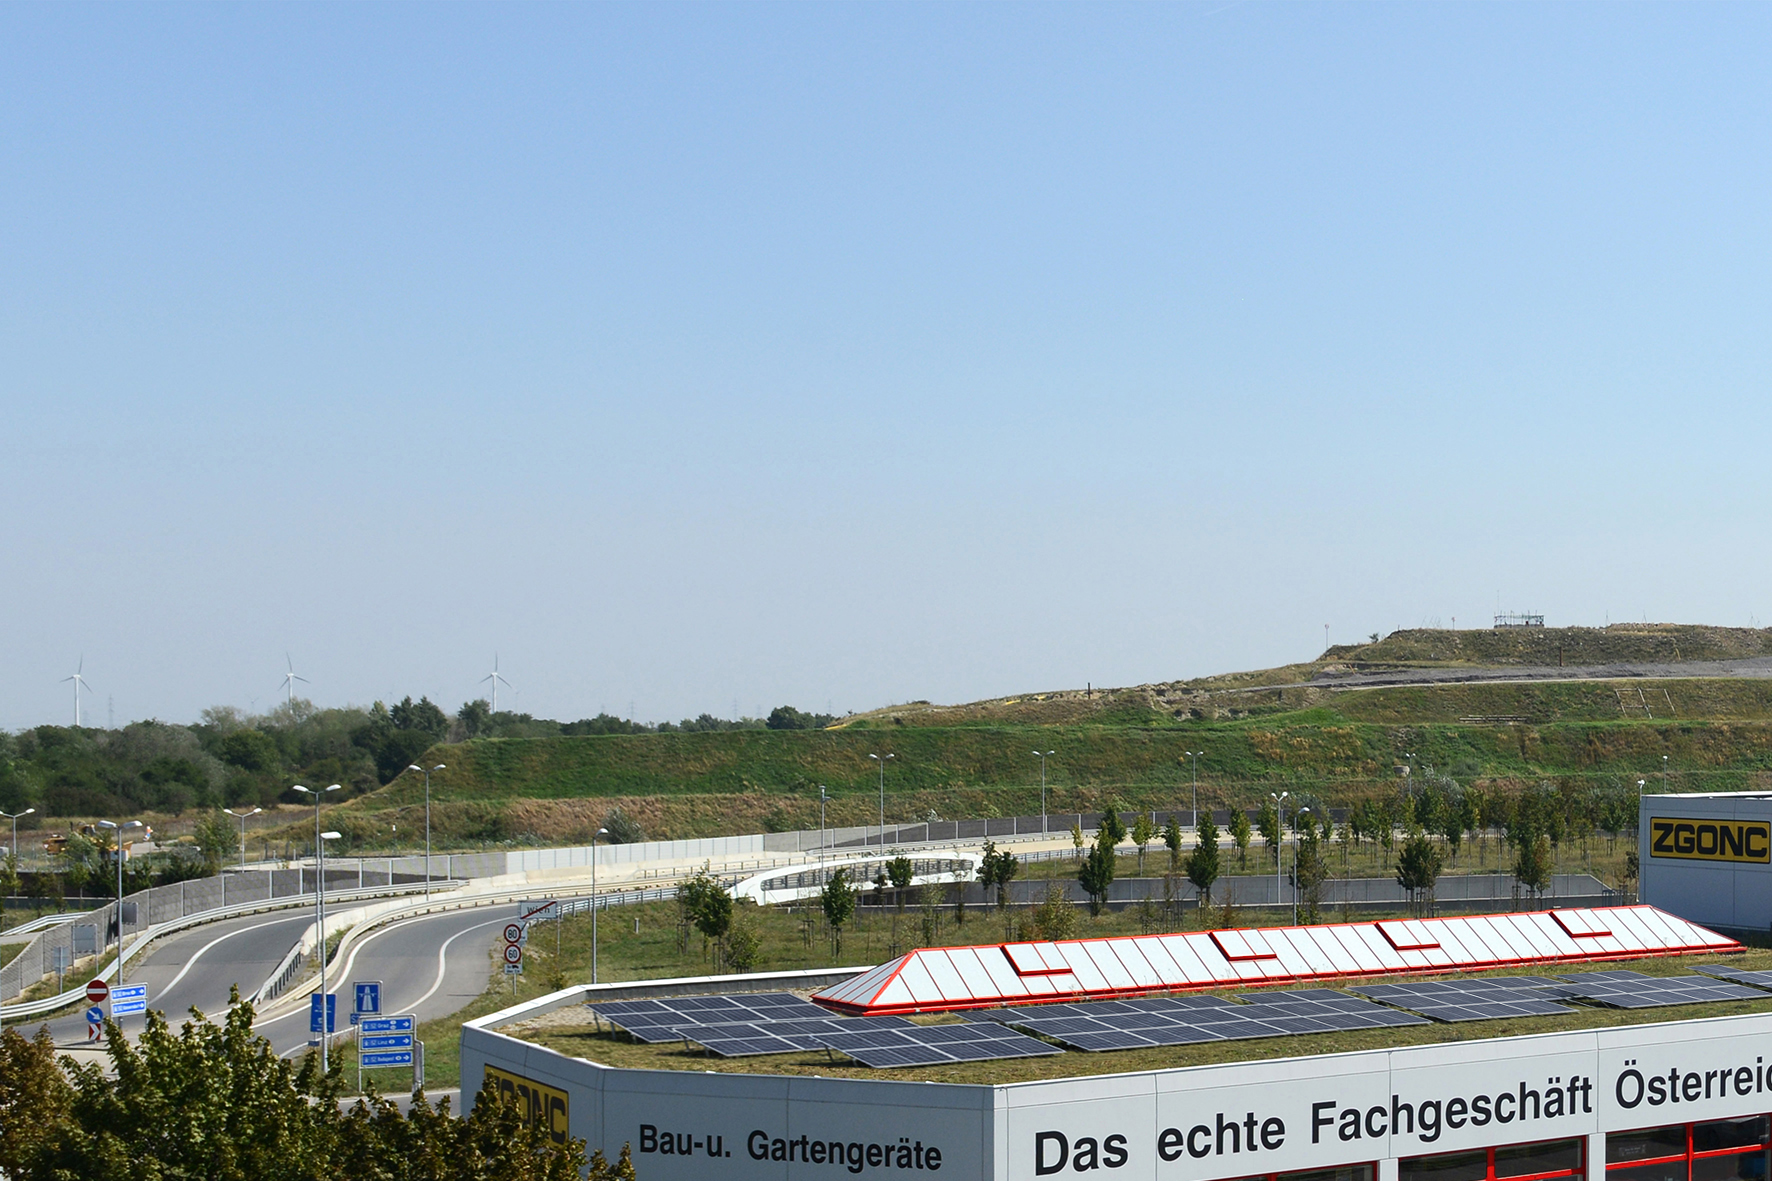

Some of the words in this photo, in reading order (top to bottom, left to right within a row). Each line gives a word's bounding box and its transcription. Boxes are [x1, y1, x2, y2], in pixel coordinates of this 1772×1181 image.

[1653, 822, 1768, 858] ZGONC
[527, 905, 550, 914] Wien
[508, 929, 517, 939] 80
[508, 949, 517, 959] 60
[1035, 1129, 1129, 1176] Das
[1157, 1111, 1286, 1162] echte
[1311, 1075, 1592, 1144] Fachgeschäft
[747, 1130, 942, 1174] Gartengeräte
